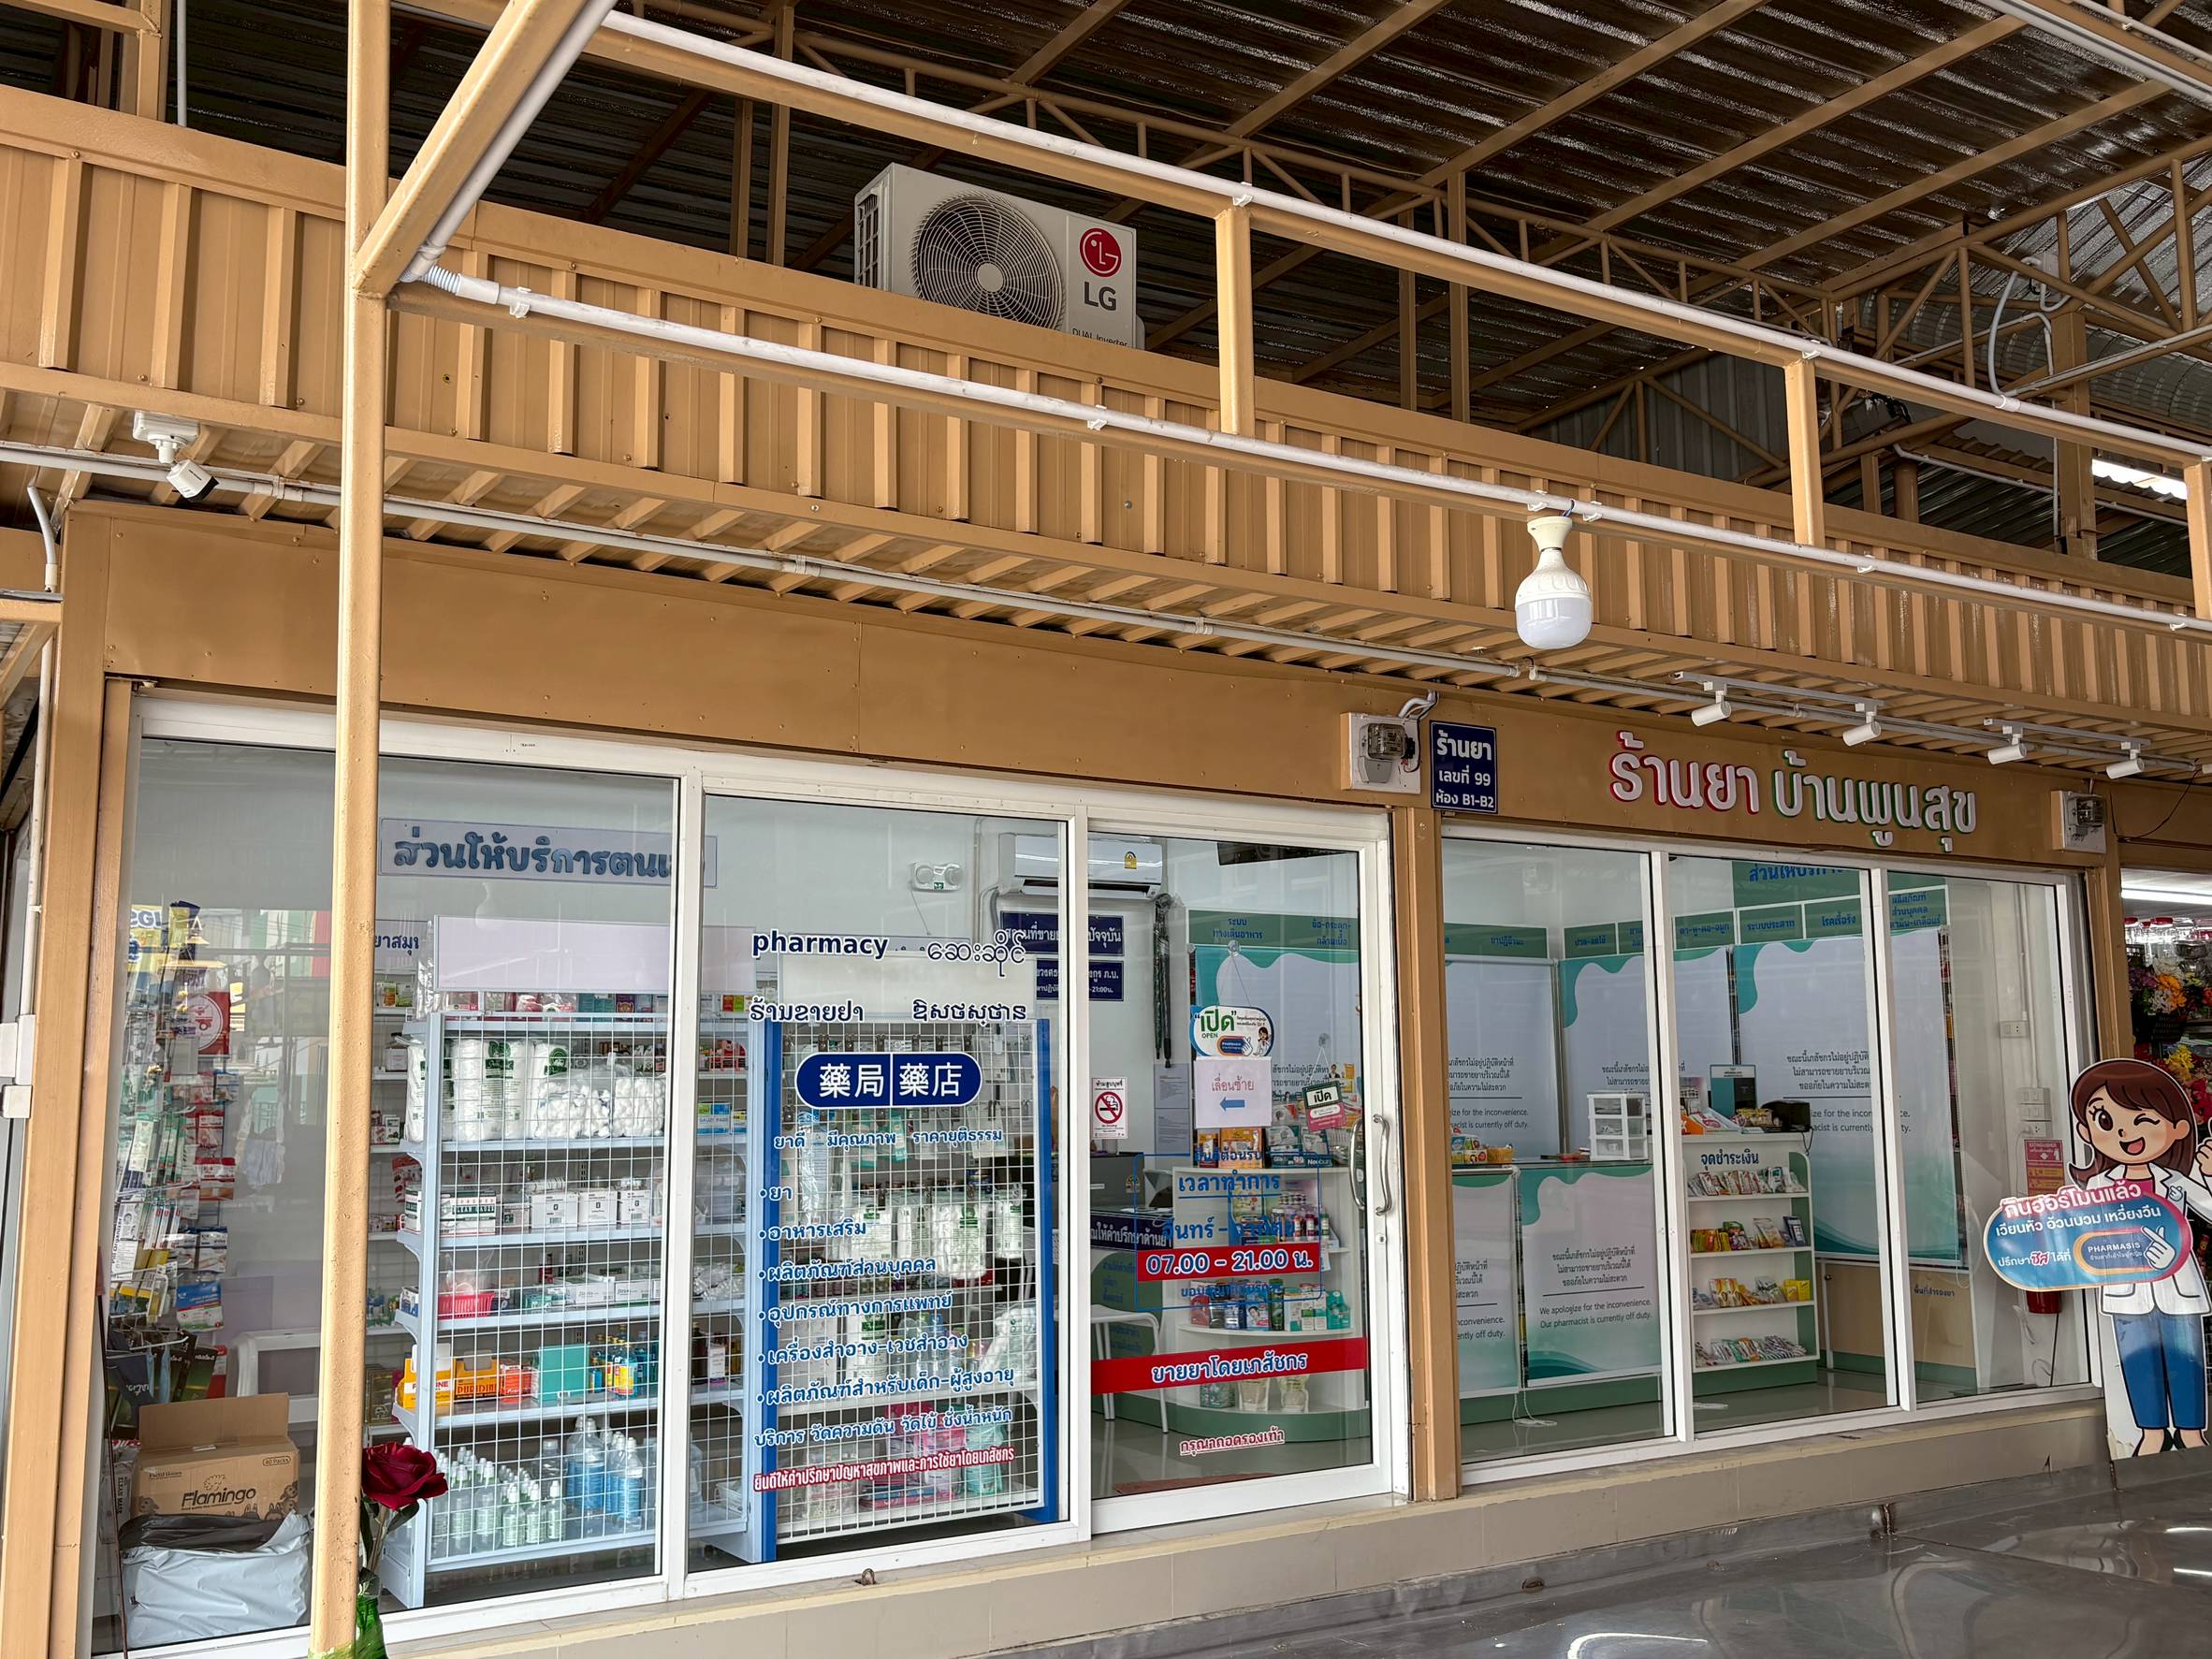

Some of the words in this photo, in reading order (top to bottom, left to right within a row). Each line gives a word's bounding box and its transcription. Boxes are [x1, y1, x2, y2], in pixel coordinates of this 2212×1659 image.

[1084, 282, 1116, 311] LG
[1436, 729, 1492, 761] ร้านยา
[1438, 764, 1470, 784] เลขที่
[1474, 772, 1492, 787] 99
[1435, 789, 1459, 806] ห้อง
[1462, 793, 1495, 809] B1-B2
[1609, 730, 1761, 815] ร้านยา
[1773, 749, 1978, 852] บ้านพูนสุข
[394, 826, 672, 878] ส่วนให้บริการตนเ
[752, 930, 889, 960] pharmacy
[819, 1063, 884, 1099] 藥局
[898, 1061, 963, 1098] 藥店
[1212, 1073, 1255, 1092] เลื่อนซ้าย
[1314, 1091, 1332, 1103] เปิด
[1824, 1109, 1835, 1117] for
[1837, 1109, 1851, 1117] the
[773, 1131, 806, 1150] ยาดี
[826, 1129, 896, 1151] มีคุณภาพ
[912, 1127, 1004, 1145] ราคายุติธรรม
[1700, 1149, 1760, 1171] จุดชำระเงิน
[768, 1186, 793, 1201] ยา
[1178, 1170, 1280, 1193] เวลาทำการ
[2003, 1180, 2142, 1219] กินฮอร์โมนแล้ว
[768, 1217, 867, 1241] อาหารเสริม
[1996, 1220, 2044, 1237] เวียนหัว
[2046, 1215, 2102, 1230] อ้วนบวม
[2103, 1204, 2161, 1224] เหวี่ยงวีน
[2050, 1247, 2072, 1262] ได้ที่
[2088, 1242, 2141, 1253] PHARMASIS
[767, 1257, 937, 1282] ผลิตภัณฑ์ส่วนบุคคล
[1145, 1254, 1211, 1274] 07.00
[1231, 1249, 1288, 1272] 21.00
[1293, 1250, 1315, 1269] น.
[768, 1289, 953, 1329] อุปกรณ์ทางการแพทย์
[1551, 1305, 1582, 1316] apologize
[1606, 1299, 1652, 1309] inconvenience.
[1553, 1317, 1589, 1329] pharmacist
[1596, 1314, 1624, 1325] currently
[1636, 1311, 1652, 1320] duty.
[767, 1333, 968, 1364] เครื่องสำอาง-เวชสำอาง
[1152, 1350, 1308, 1383] ขายยาโดยเภสัชกร
[766, 1367, 1015, 1405] ผลิตภัณฑ์สำหรับเด็ก-ผู้สูงอายุ
[754, 1429, 805, 1448] บริการ
[811, 1419, 895, 1441] วัดความดัน
[902, 1412, 938, 1433] วัดไข้
[943, 1406, 1012, 1428] ชั่งน้ำหนัก
[1179, 1426, 1286, 1456] กรุณาถอดรองเท้า
[754, 1446, 1014, 1492] ยินดีให้คำปรึกษาปัญหาสุขภาพและการใช้ยาโดยเภสัชกร
[182, 1486, 256, 1508] Flamingo
